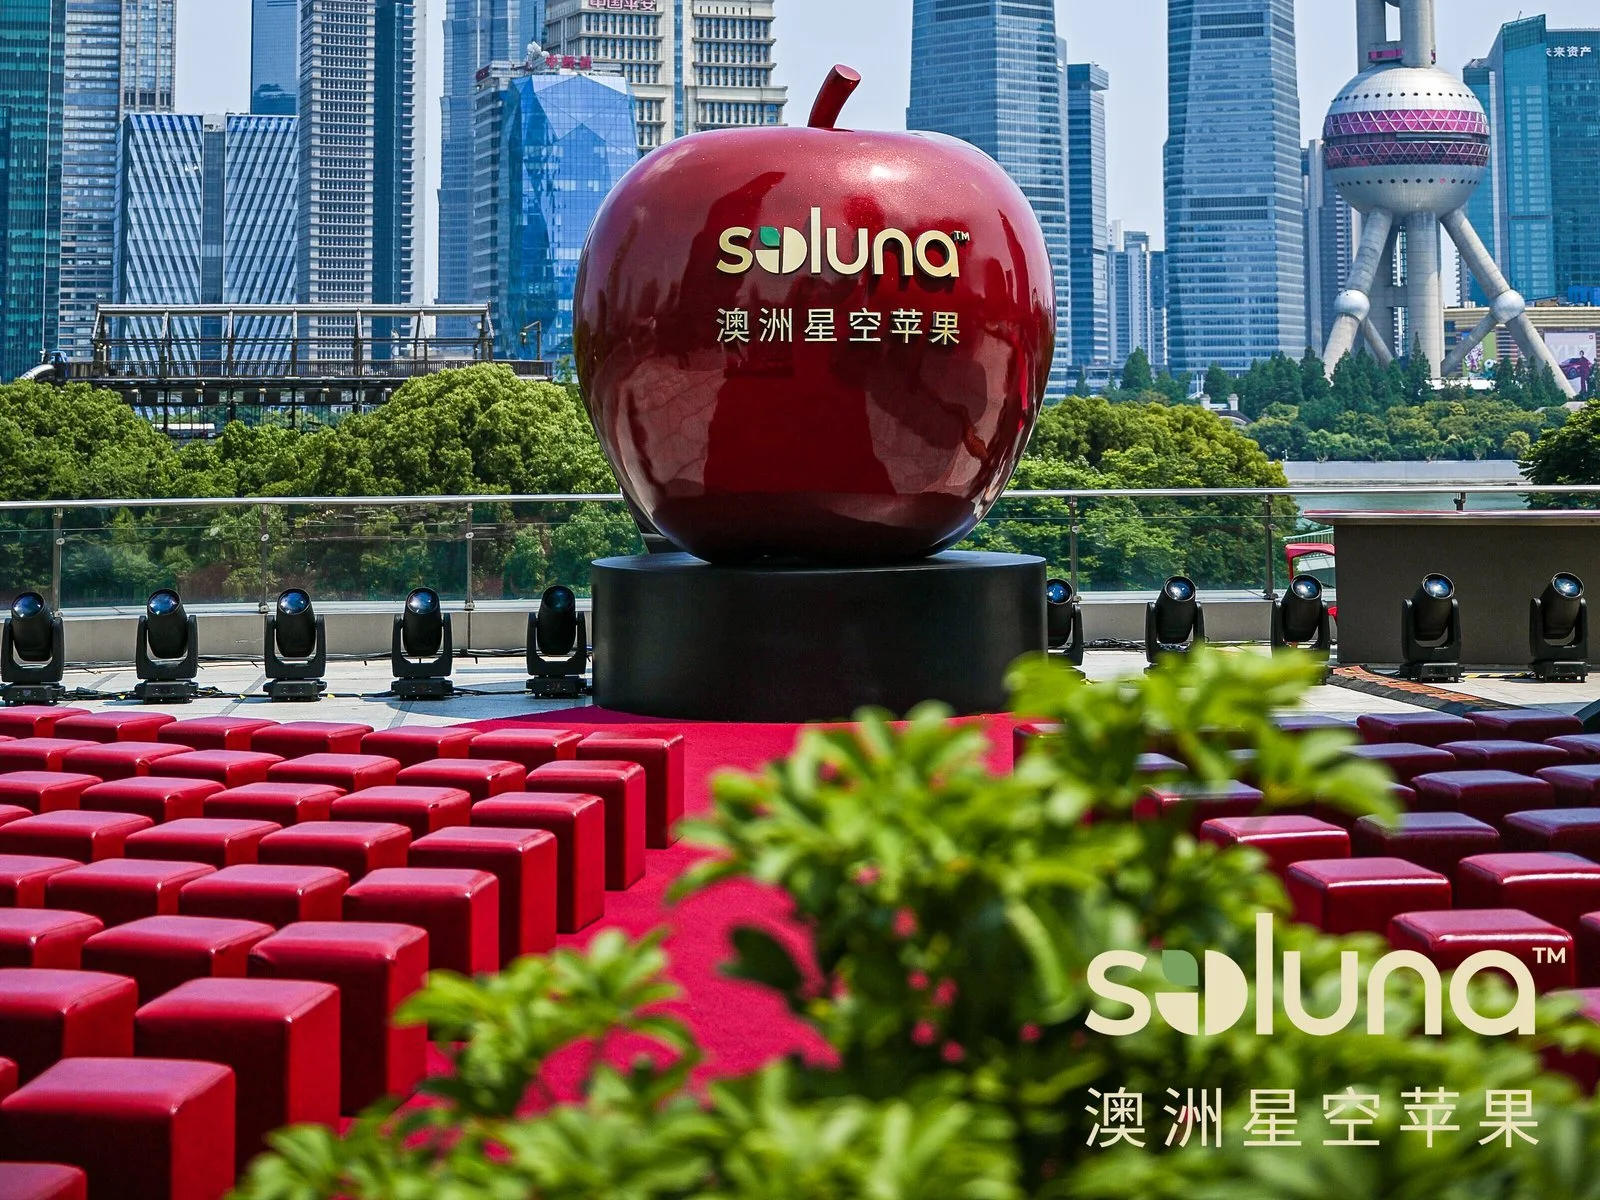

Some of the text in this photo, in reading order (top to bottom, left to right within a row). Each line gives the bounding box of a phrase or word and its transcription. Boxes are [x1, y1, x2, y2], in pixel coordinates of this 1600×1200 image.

[716, 206, 959, 278] soluna
[716, 307, 960, 345] 澳洲星空苹果
